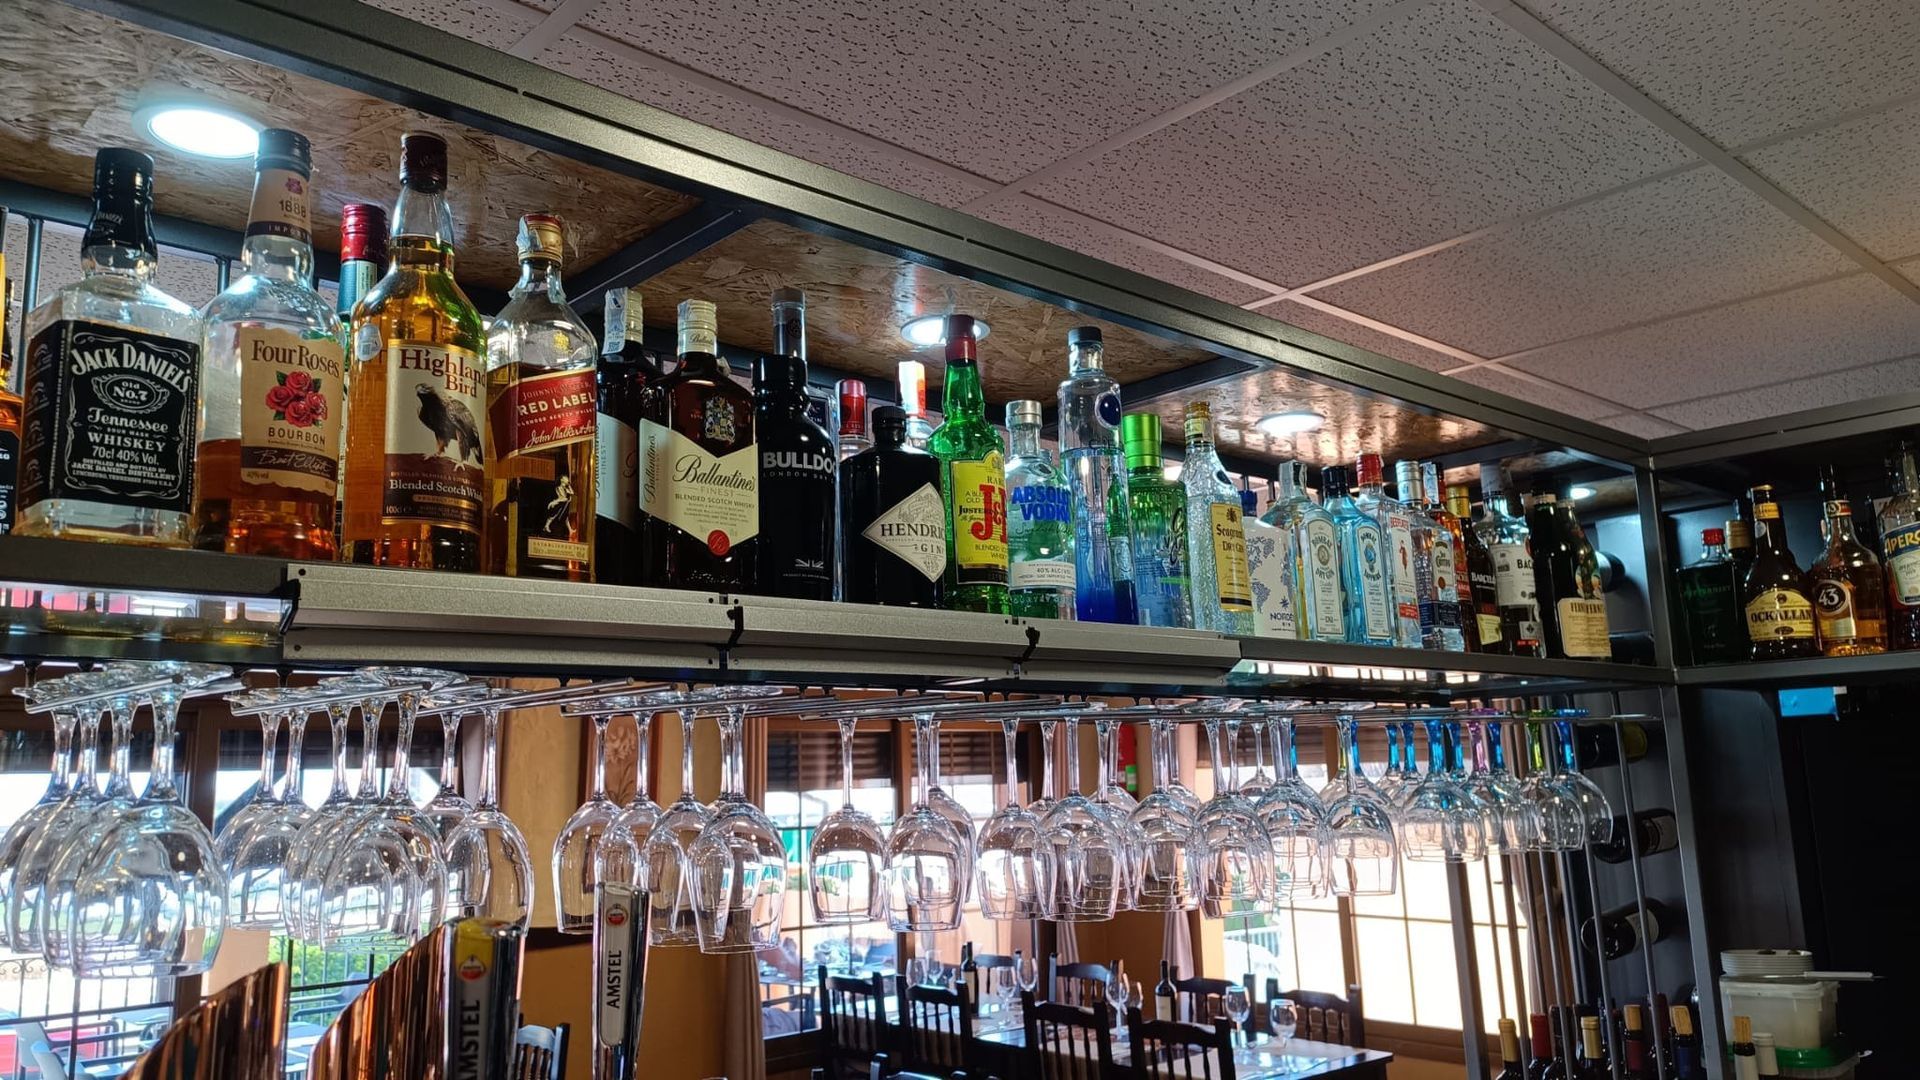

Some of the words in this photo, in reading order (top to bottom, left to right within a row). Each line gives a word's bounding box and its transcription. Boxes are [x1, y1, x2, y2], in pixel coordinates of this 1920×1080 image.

[280, 199, 306, 218] 1888
[71, 347, 120, 375] JACK
[123, 343, 193, 393] DANIEL'S
[251, 339, 298, 365] Four
[297, 344, 340, 379] Roses
[399, 348, 487, 389] Highland
[121, 380, 140, 389] Old
[444, 374, 478, 399] Bird
[517, 400, 549, 416] RED
[552, 391, 595, 410] LABEL
[87, 407, 169, 433] Tennessee
[88, 431, 166, 452] WHISKEY
[268, 426, 326, 446] BOURBON
[92, 445, 115, 459] 70cl
[116, 450, 140, 463] 40%
[141, 452, 160, 465] Vol.
[763, 451, 836, 475] BULLDO
[71, 461, 94, 471] JACK
[95, 464, 126, 475] DANIEL
[672, 453, 757, 493] Ballantine's
[389, 479, 434, 492] Blended
[435, 481, 467, 497] Scotch
[700, 486, 735, 498] FINEST
[675, 493, 706, 502] BLENDED
[707, 496, 733, 506] SCOTCH
[1818, 586, 1841, 607] 43
[605, 950, 623, 1010] AMSTEL
[459, 1000, 480, 1080] MSTEL
